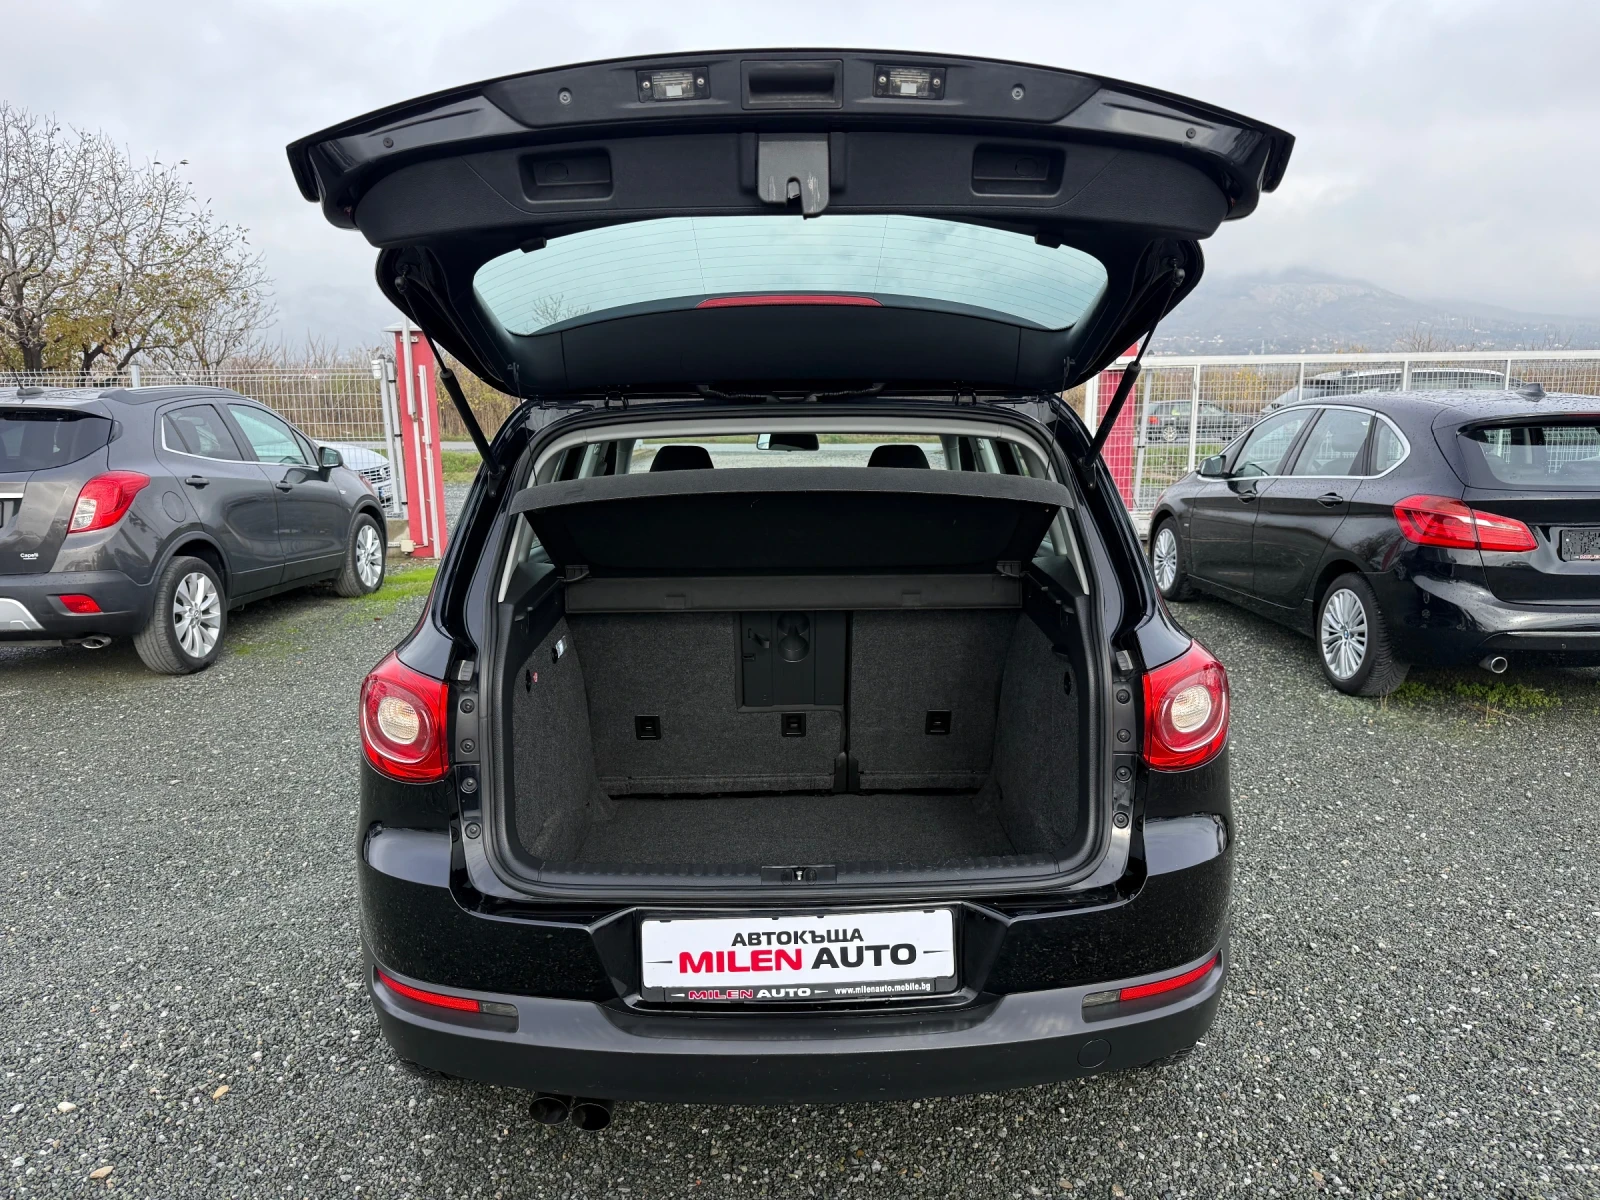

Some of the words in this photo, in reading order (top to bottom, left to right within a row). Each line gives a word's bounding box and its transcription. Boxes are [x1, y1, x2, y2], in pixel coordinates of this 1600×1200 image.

[679, 948, 802, 974] MILEN
[811, 943, 917, 969] AUTO
[688, 989, 754, 1000] MILEN
[756, 987, 811, 998] AUTO
[834, 982, 931, 995] www.milenauto.mobile.bg
